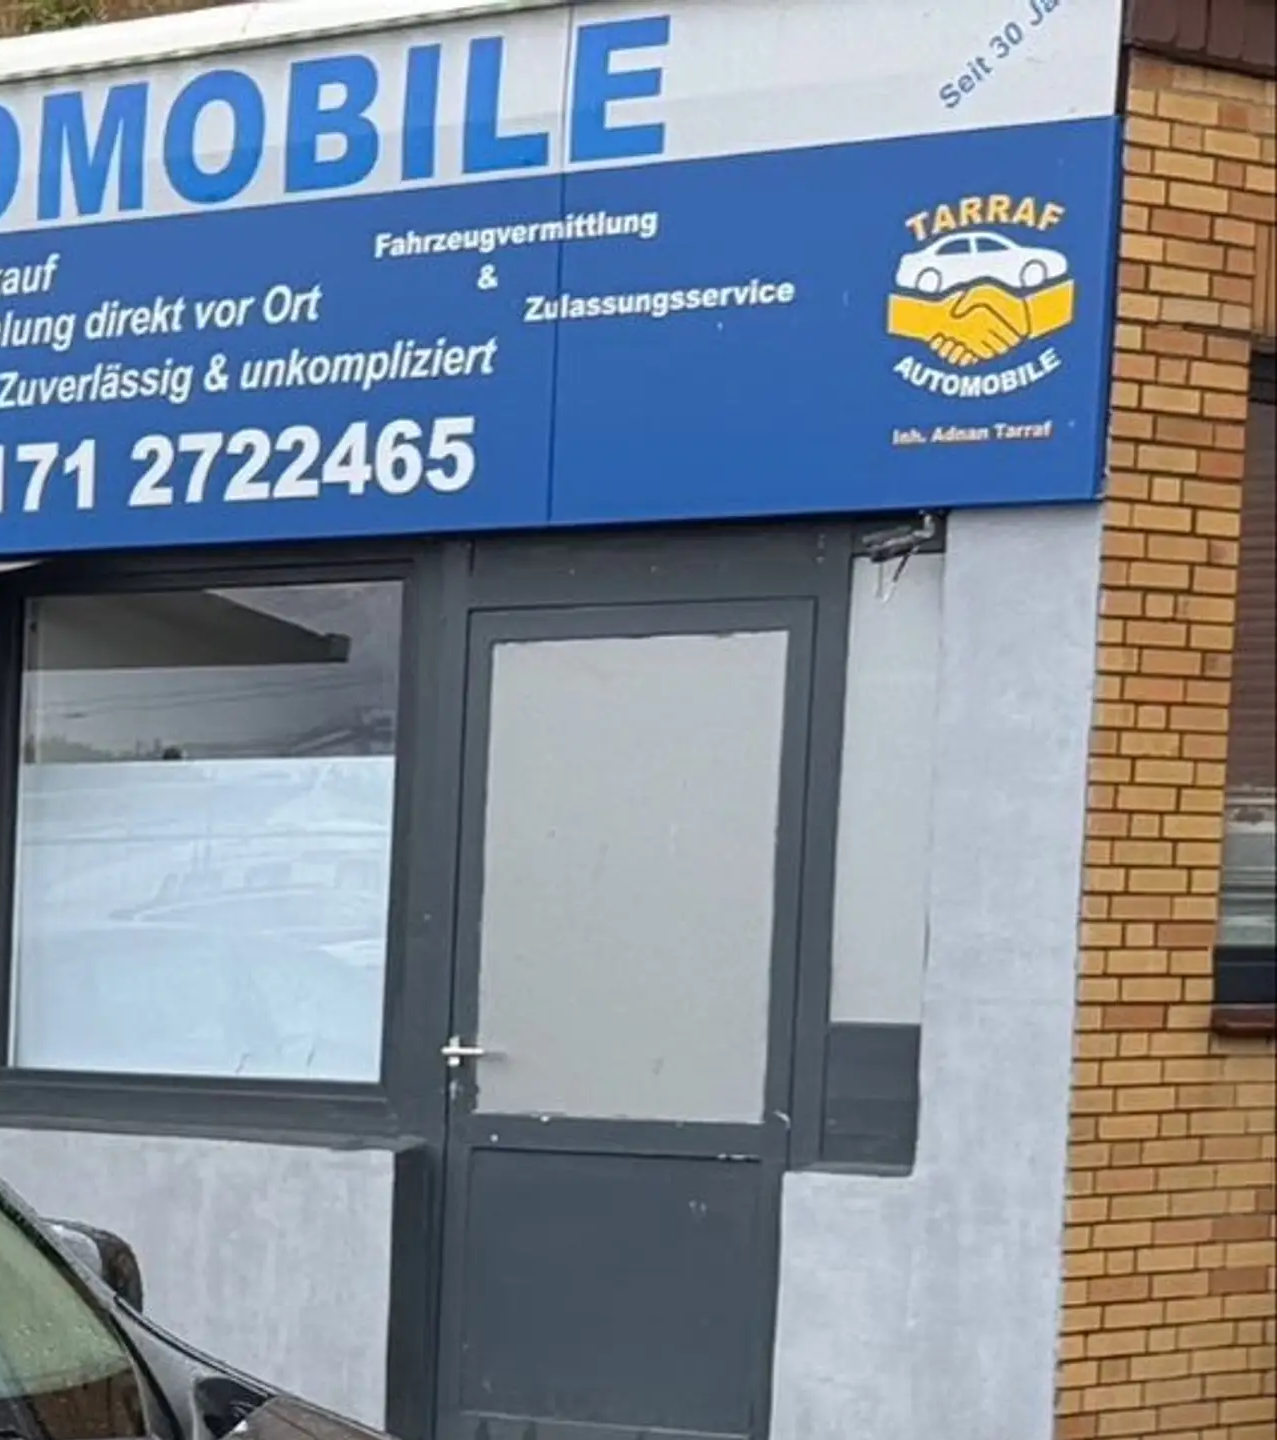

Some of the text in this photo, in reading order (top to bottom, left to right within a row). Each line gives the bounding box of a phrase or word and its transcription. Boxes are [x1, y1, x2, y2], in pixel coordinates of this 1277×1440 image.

[939, 56, 993, 109] Seit
[989, 22, 1023, 59] 30
[374, 211, 658, 258] Fahrzeugvermittlung
[905, 194, 1065, 241] TARRAF
[477, 264, 498, 290] &
[523, 279, 795, 323] Zulassungsservice
[84, 295, 185, 340] direkt
[195, 296, 254, 329] vor
[262, 284, 323, 324] Ort
[203, 353, 228, 392] &
[239, 336, 500, 391] unkompliziert
[893, 347, 1062, 398] AUTOMOBILE
[931, 425, 988, 443] Adnan
[994, 420, 1053, 439] Tarraf
[128, 416, 476, 508] 2722465
